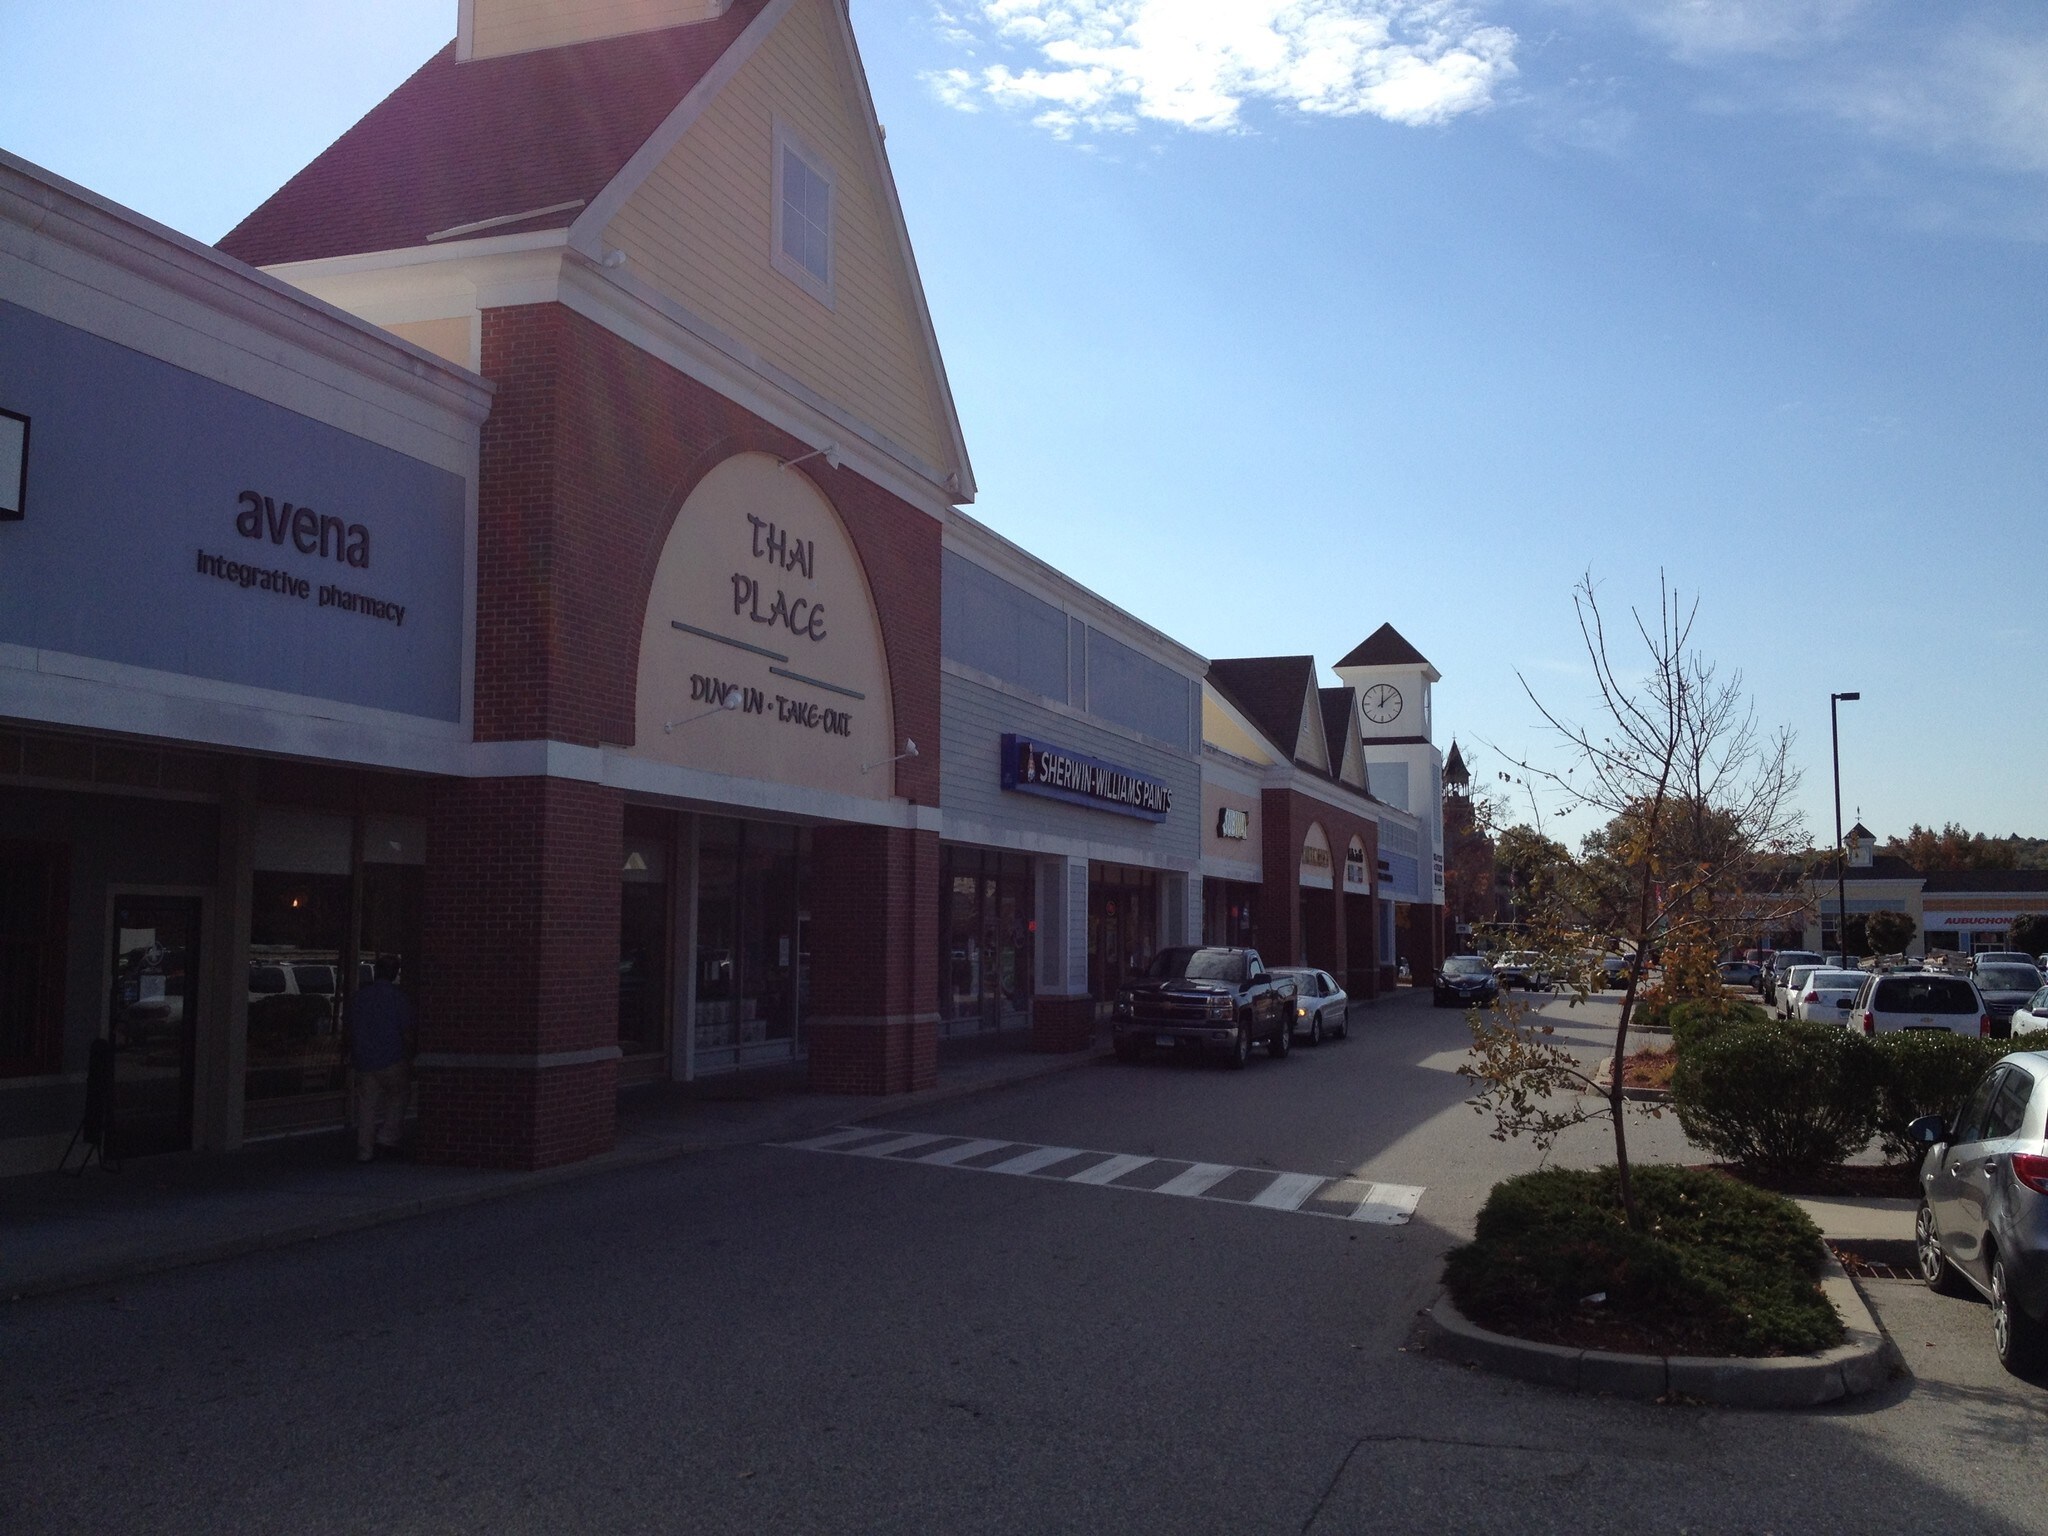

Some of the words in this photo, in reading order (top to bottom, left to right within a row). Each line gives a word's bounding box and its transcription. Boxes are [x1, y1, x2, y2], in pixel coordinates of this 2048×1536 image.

[236, 489, 370, 569] avena
[747, 512, 814, 579] THAI
[197, 549, 310, 600] integrative
[318, 584, 406, 627] pharmacy
[731, 572, 827, 642] PLACE
[742, 687, 764, 714] IN
[775, 695, 852, 737] TAKE-OUT
[1039, 751, 1142, 805] SHERWIN-WILLIAMS
[1142, 783, 1173, 813] PAINTS
[1944, 917, 2012, 925] AUBUCHON
